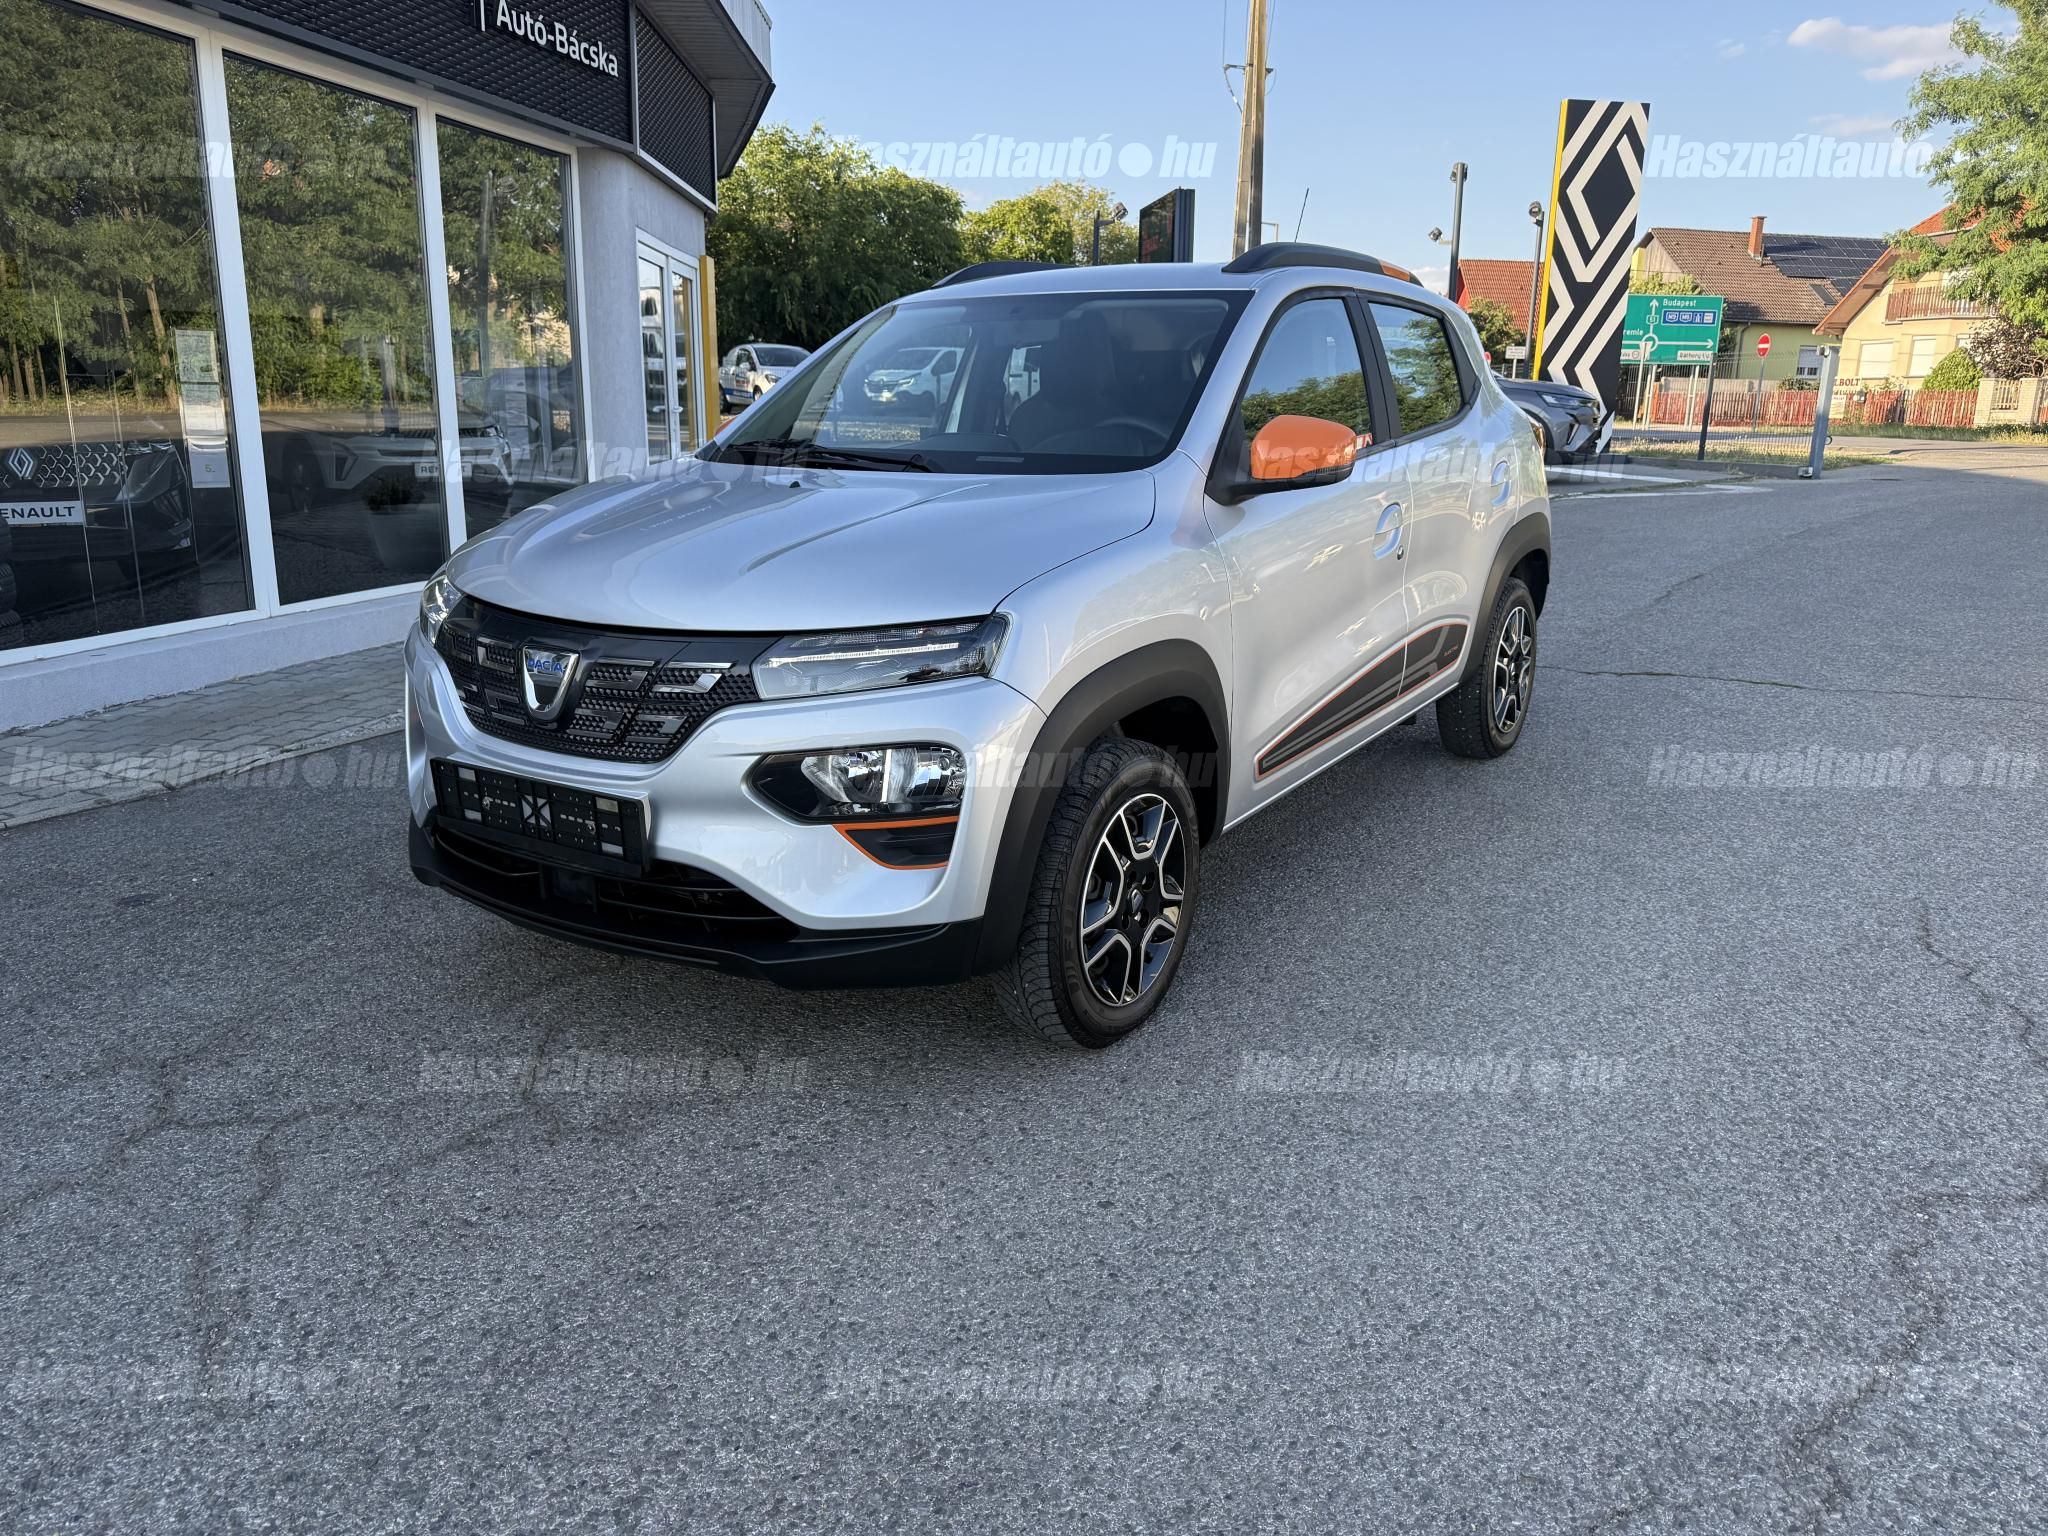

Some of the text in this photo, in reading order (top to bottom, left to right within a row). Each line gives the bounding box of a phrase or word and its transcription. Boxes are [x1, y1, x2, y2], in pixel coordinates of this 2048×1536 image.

[497, 0, 618, 77] Autó-Bácska
[1663, 299, 1697, 307] Budapest
[527, 658, 563, 673] DACIA
